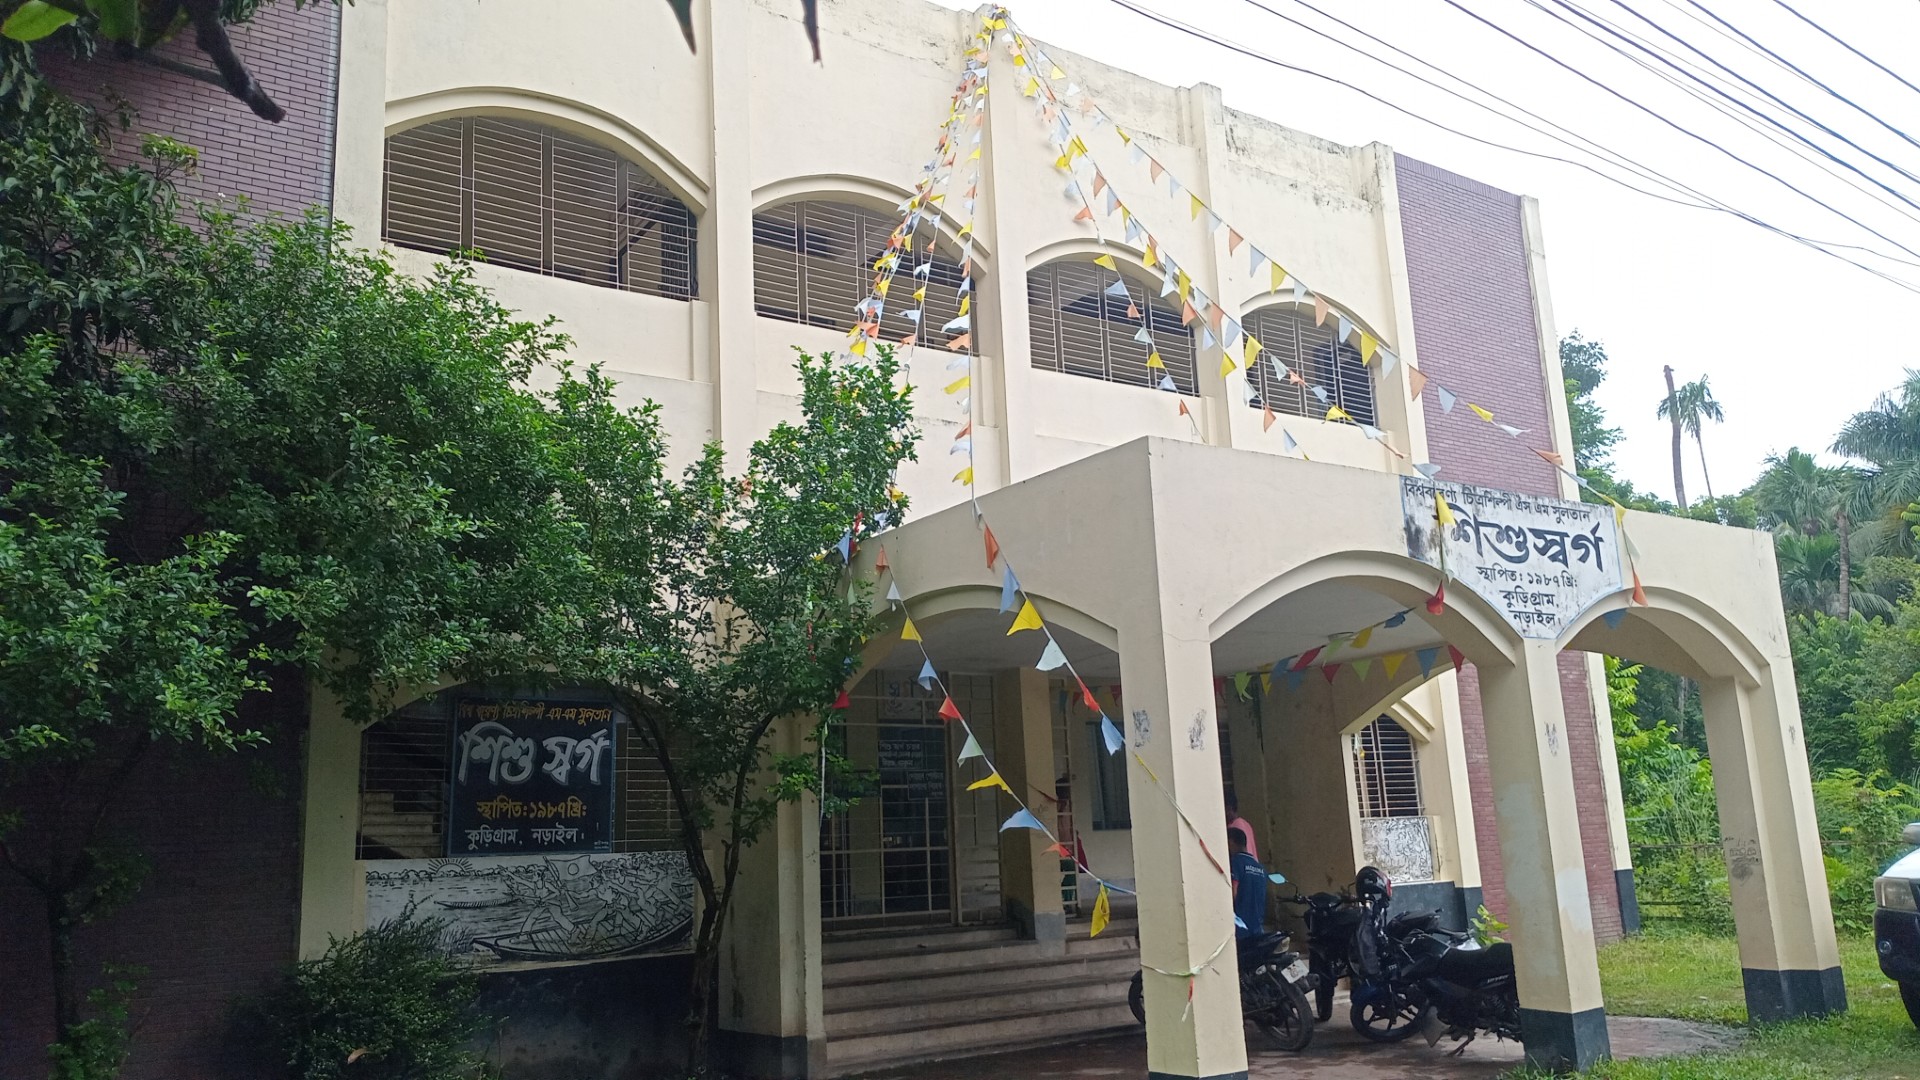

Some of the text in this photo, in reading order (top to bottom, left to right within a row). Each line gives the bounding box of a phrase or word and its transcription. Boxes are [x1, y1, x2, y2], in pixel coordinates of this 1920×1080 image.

[1534, 503, 1549, 517] এম
[1550, 505, 1591, 525] সুলতান
[458, 721, 610, 786] শিশু স্বর্গ
